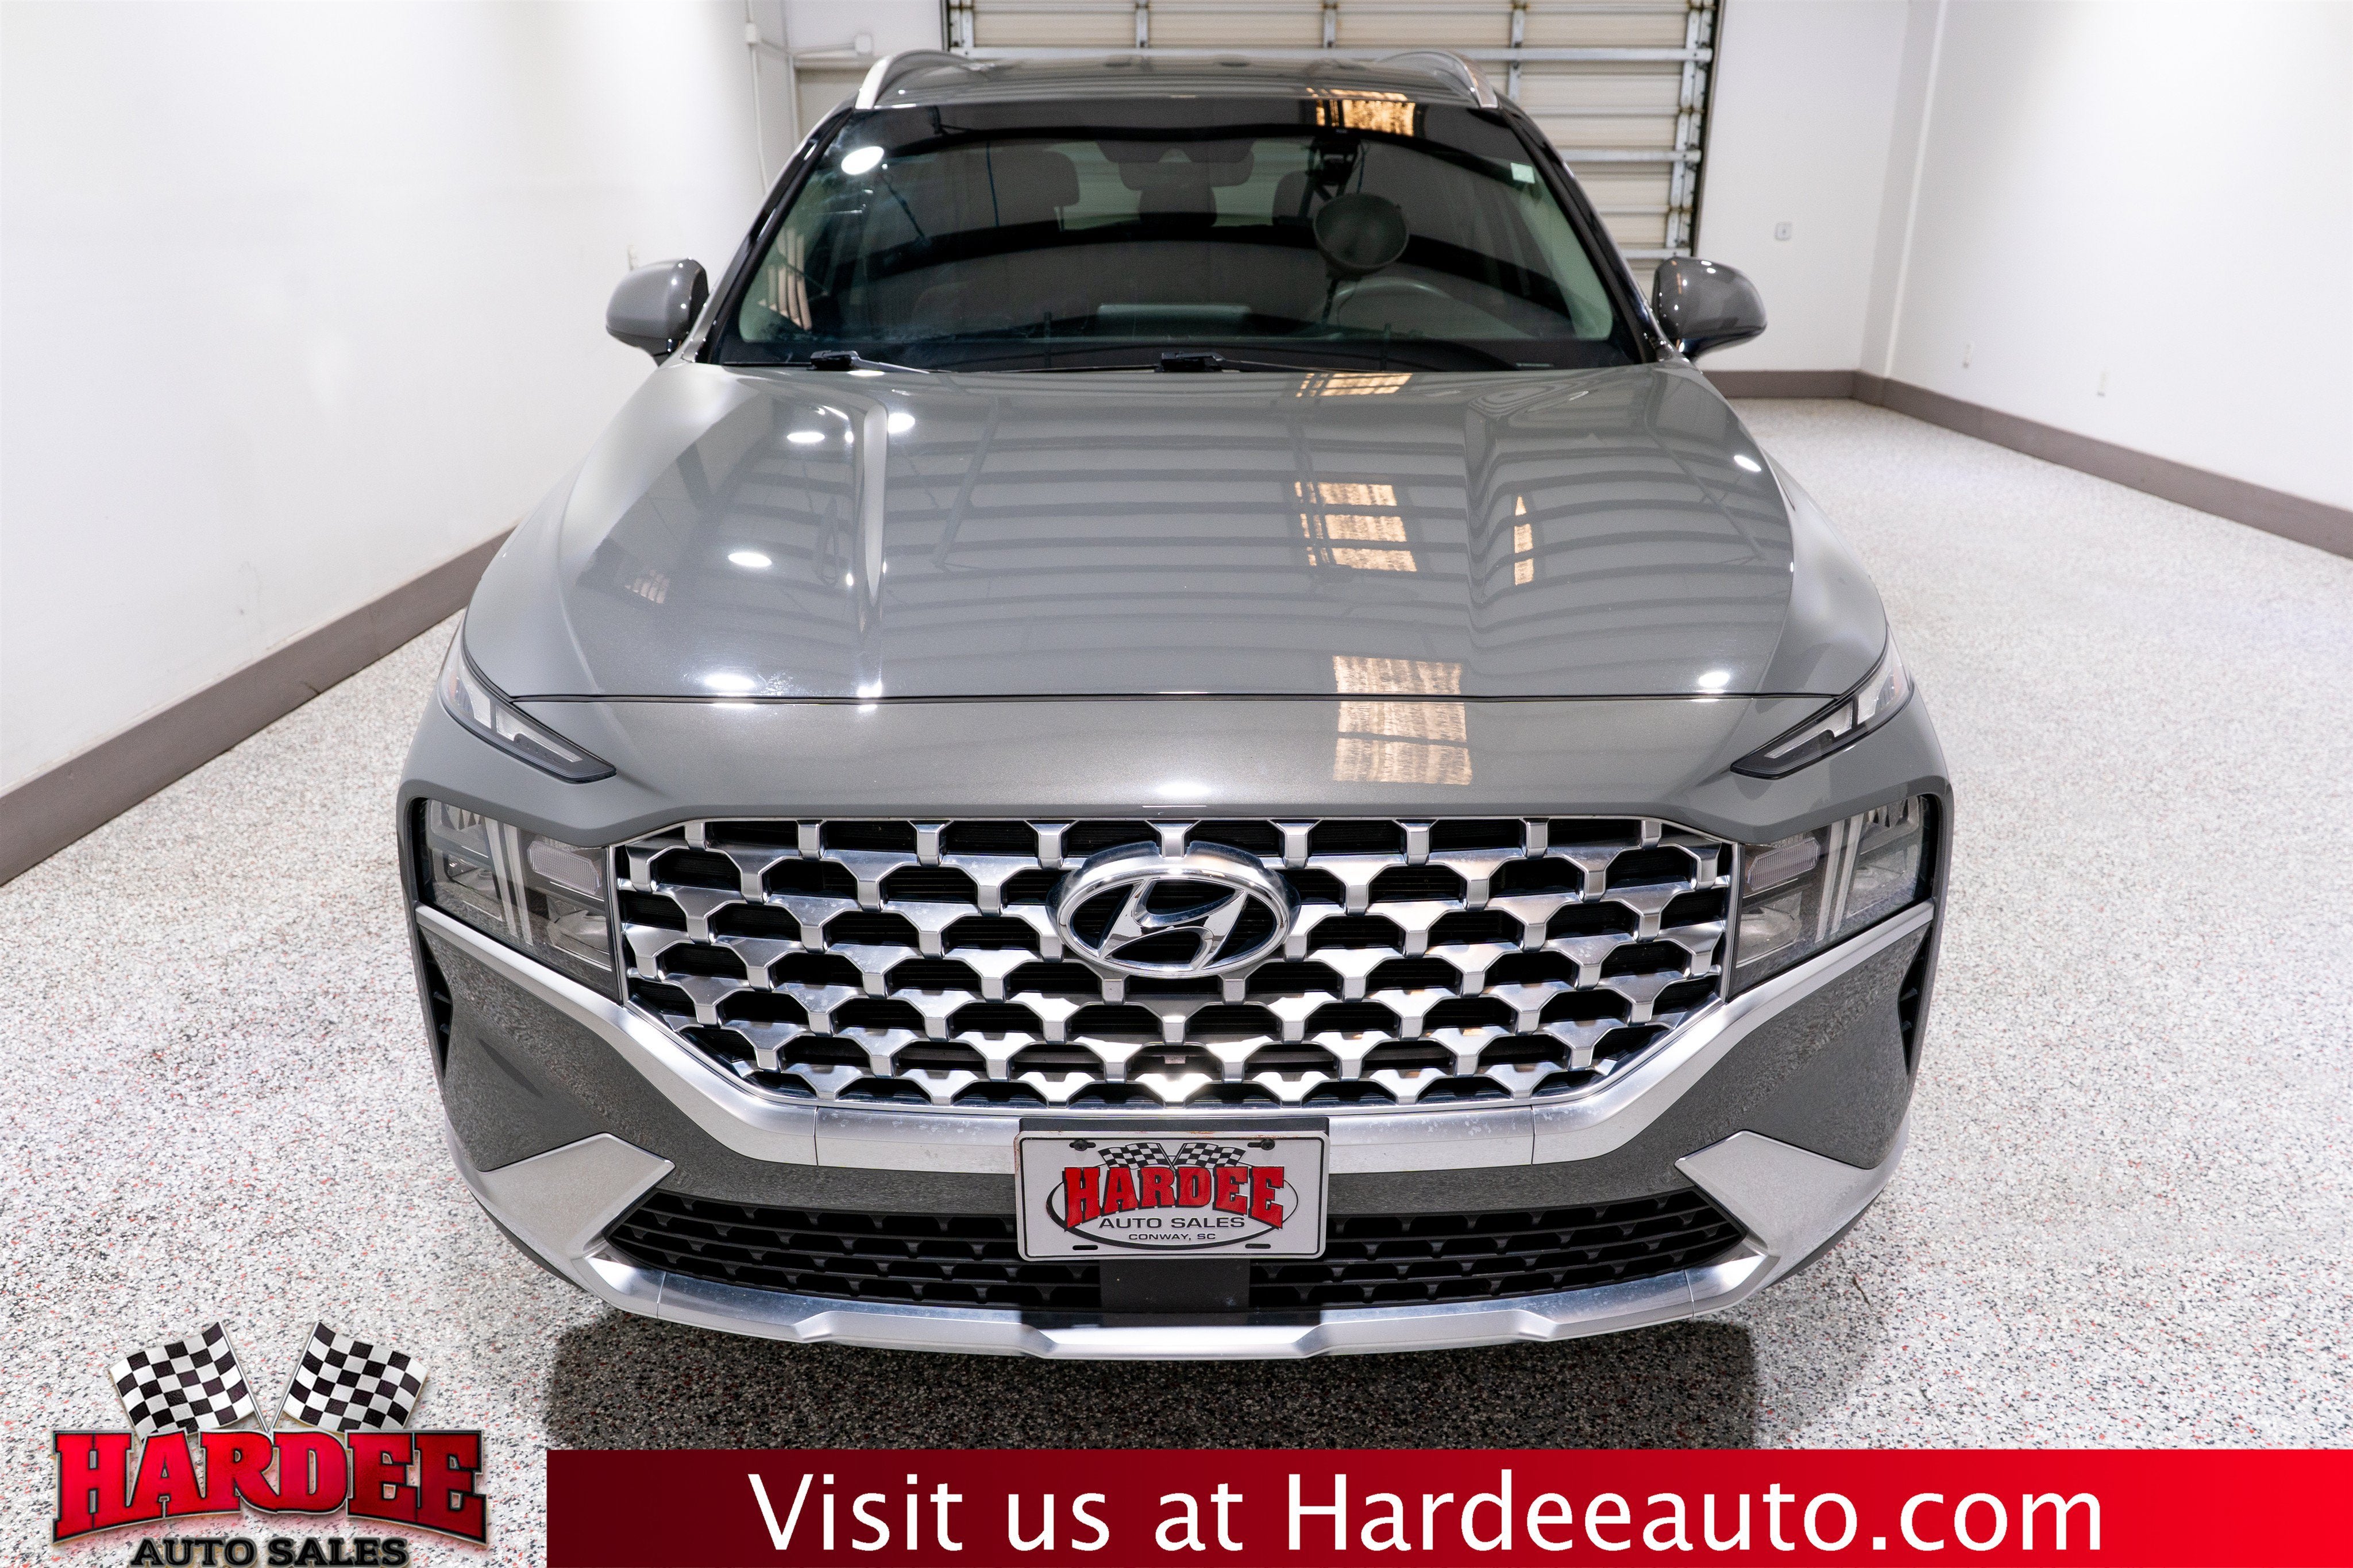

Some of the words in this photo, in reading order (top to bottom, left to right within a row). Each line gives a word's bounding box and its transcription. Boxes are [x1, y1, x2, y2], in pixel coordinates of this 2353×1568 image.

[1062, 1166, 1284, 1232] HARDEE
[1098, 1218, 1162, 1229] AUTO
[1171, 1217, 1245, 1228] SALES
[1128, 1233, 1191, 1241] CONWAY,
